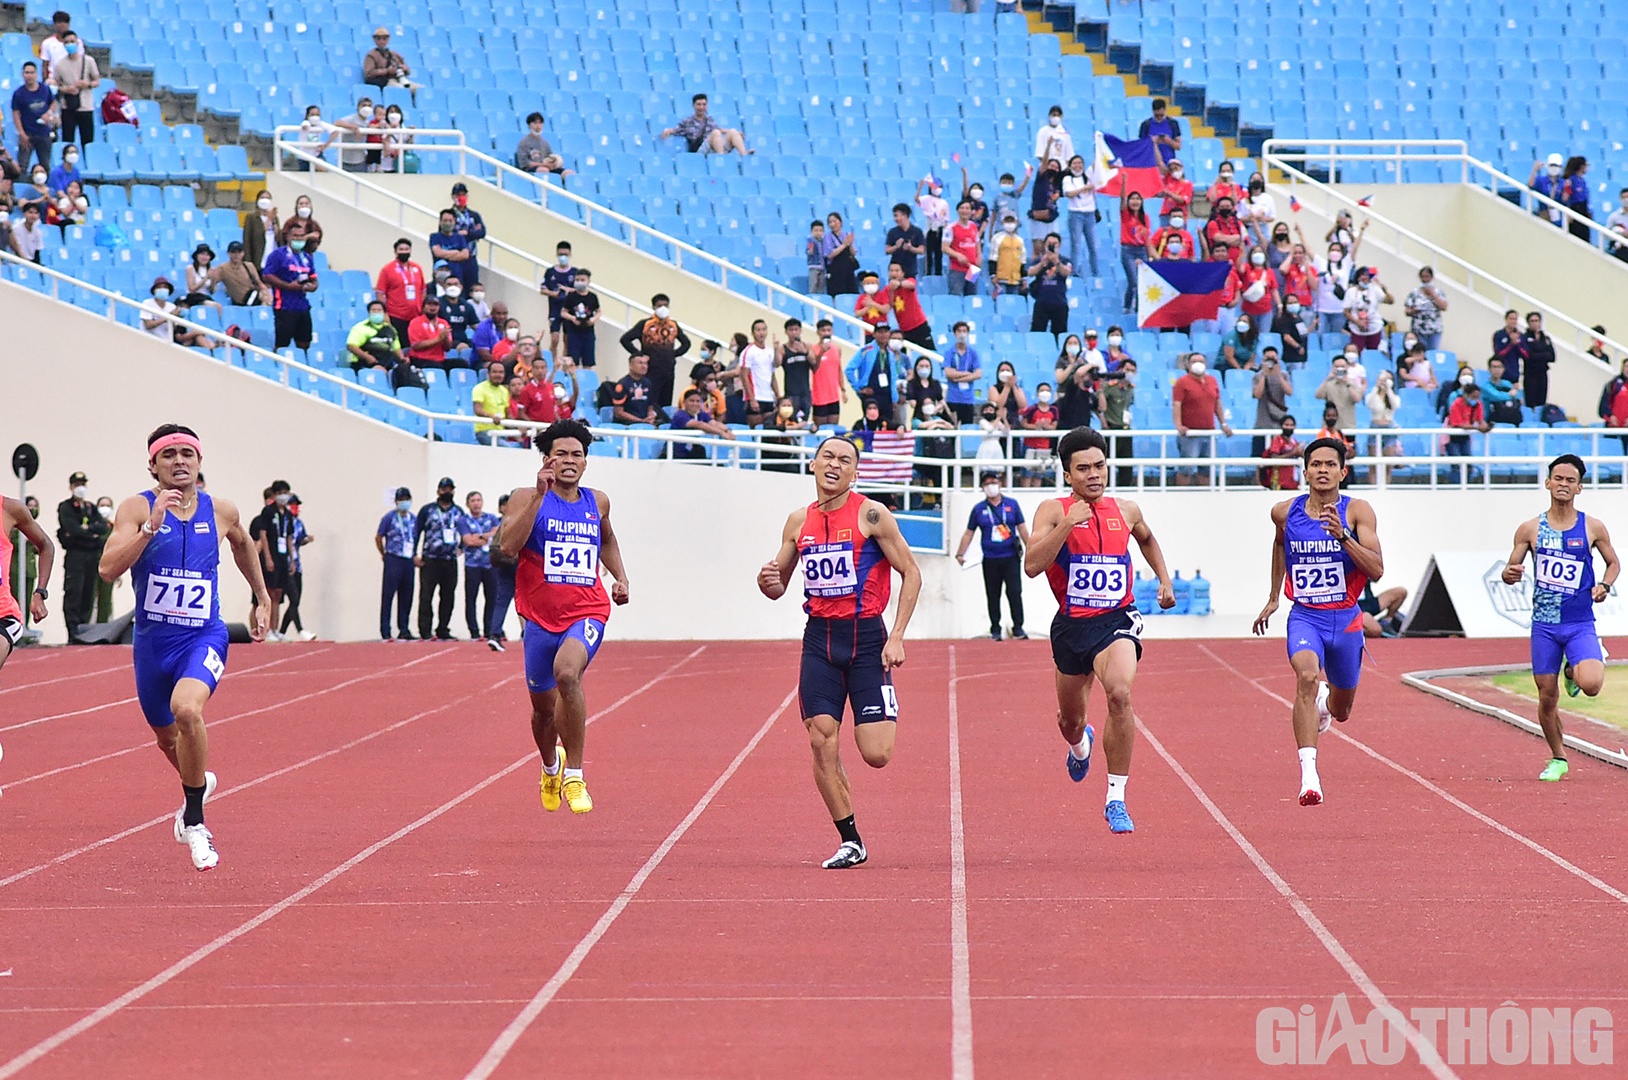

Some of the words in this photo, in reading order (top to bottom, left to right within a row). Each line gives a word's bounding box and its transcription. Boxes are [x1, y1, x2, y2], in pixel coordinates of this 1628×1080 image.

[548, 518, 598, 537] PILIPINAS
[575, 535, 591, 543] Games
[1542, 538, 1563, 549] CAM
[818, 544, 827, 552] SEA
[1290, 540, 1341, 554] PILIPINAS
[550, 546, 591, 570] 541
[1092, 555, 1102, 563] SEA
[1102, 556, 1118, 564] Games
[1307, 556, 1315, 564] SEA
[172, 568, 183, 577] SEA
[184, 569, 202, 579] Games
[805, 556, 850, 581] 804
[1541, 558, 1577, 582] 103
[1073, 568, 1123, 592] 803
[1295, 567, 1340, 590] 525
[153, 581, 205, 609] 712
[167, 616, 190, 626] VIETNAM
[190, 619, 204, 627] 2022
